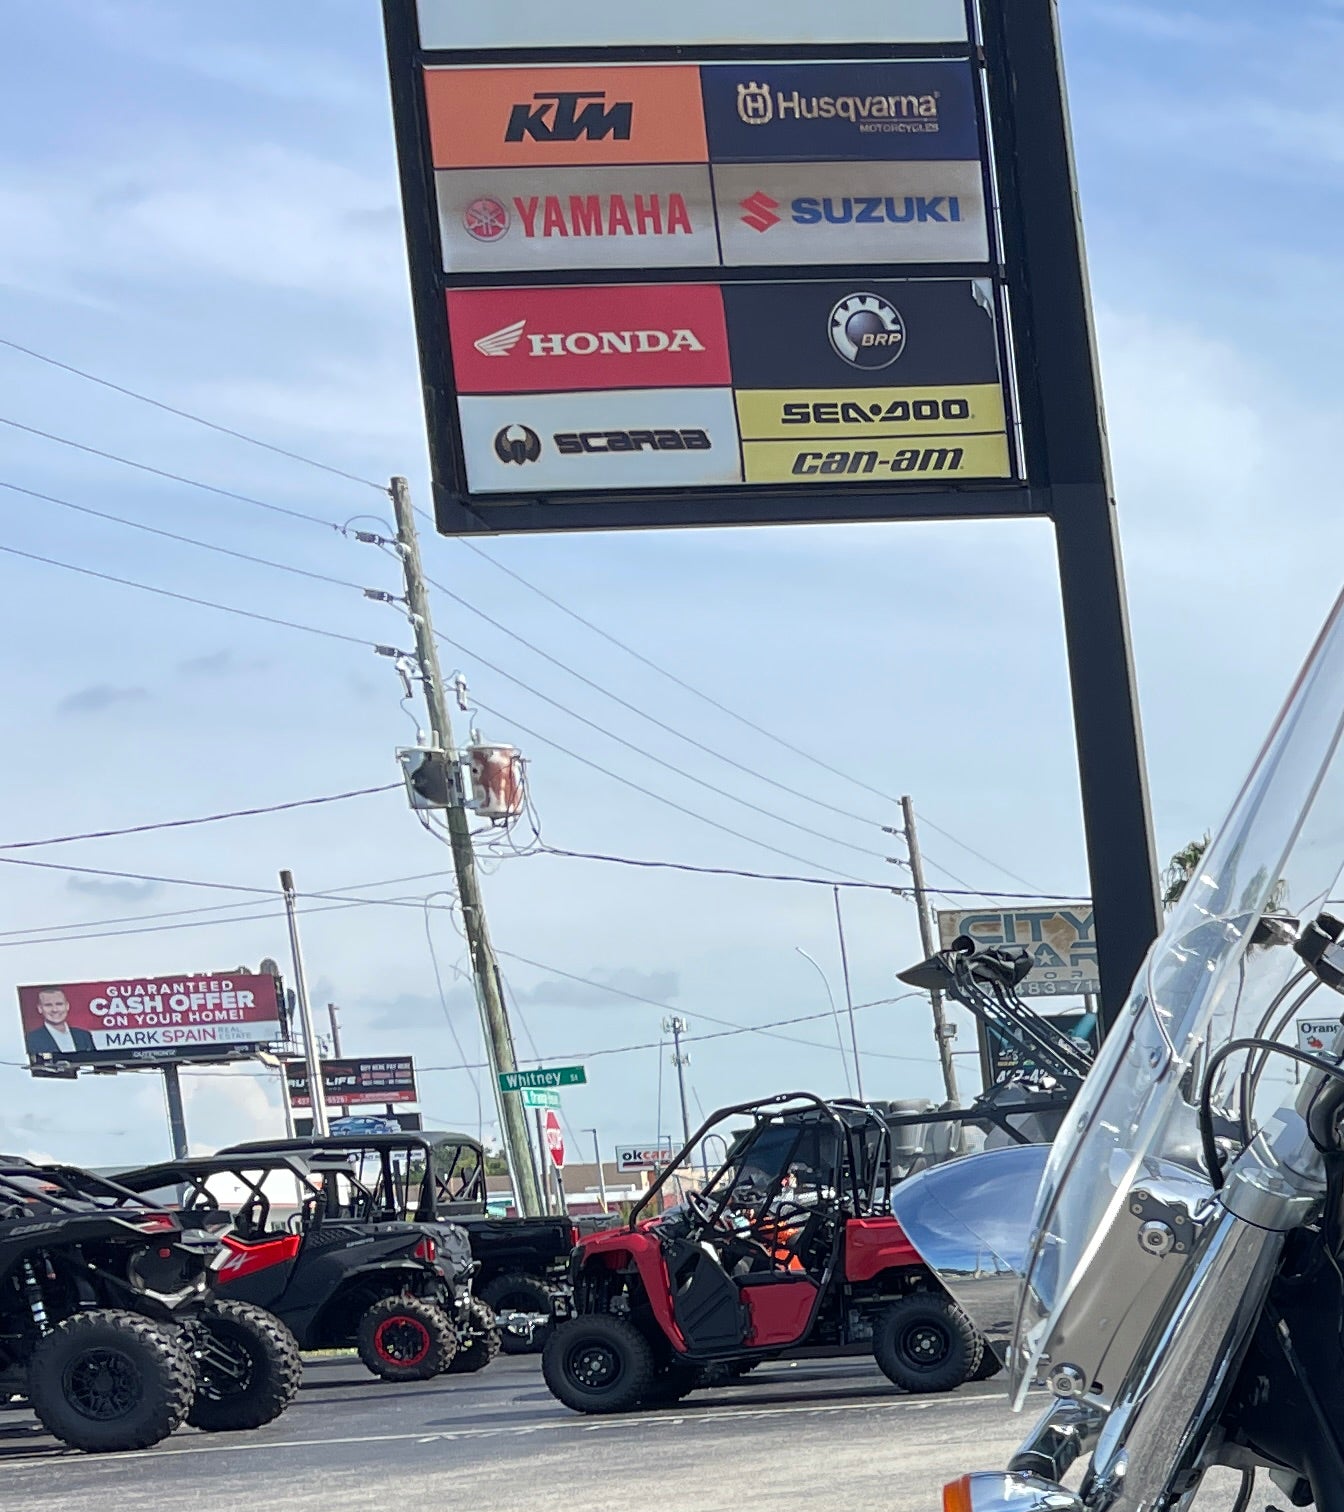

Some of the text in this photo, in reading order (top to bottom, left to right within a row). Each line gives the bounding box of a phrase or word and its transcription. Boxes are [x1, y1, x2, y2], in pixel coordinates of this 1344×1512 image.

[504, 91, 633, 142] KTM
[777, 91, 938, 122] Husqvarna
[860, 123, 940, 133] MOTORCYCLES
[513, 193, 693, 237] YAMAHA
[791, 195, 961, 224] SUZUKI
[528, 329, 706, 357] HONDA
[861, 332, 901, 348] BRP
[959, 911, 1095, 944] CITY
[106, 980, 234, 997] GUARANTEED
[88, 990, 256, 1016] CASH OFFER
[103, 1009, 245, 1027] ON YOUR HOME!
[1301, 1022, 1340, 1034] Oran
[106, 1026, 217, 1046] MARK SPAIN
[218, 1031, 252, 1040] ESTATE
[506, 1072, 562, 1089] Whitney
